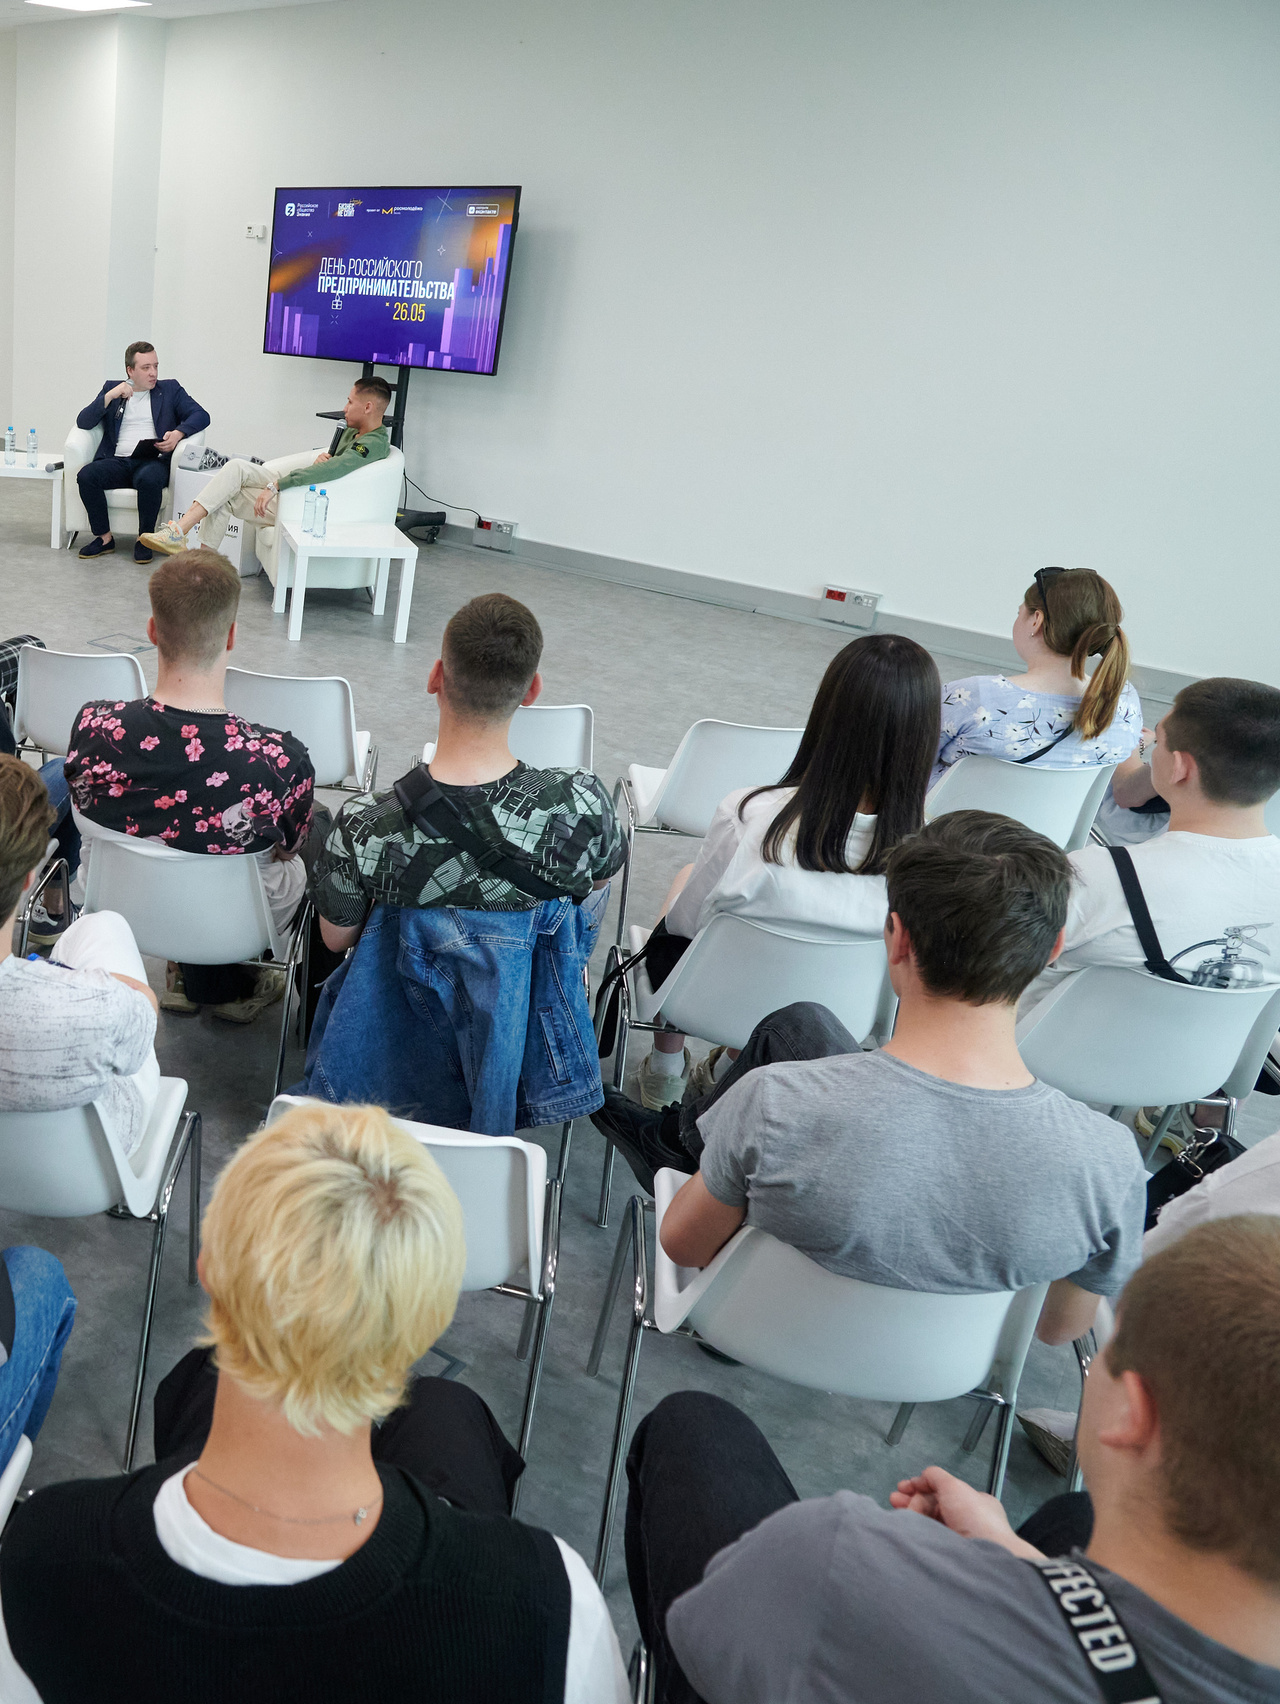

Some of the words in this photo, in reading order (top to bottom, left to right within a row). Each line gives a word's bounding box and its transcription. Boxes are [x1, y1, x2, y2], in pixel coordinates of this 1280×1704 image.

[319, 257, 346, 276] ДЕНЬ
[348, 256, 423, 279] РОССИЙСКОГО
[317, 276, 455, 300] ПРЕДПРИНИМАТЕЛЬСТВА
[393, 302, 426, 322] 26.05
[1042, 1561, 1138, 1674] FECTED
